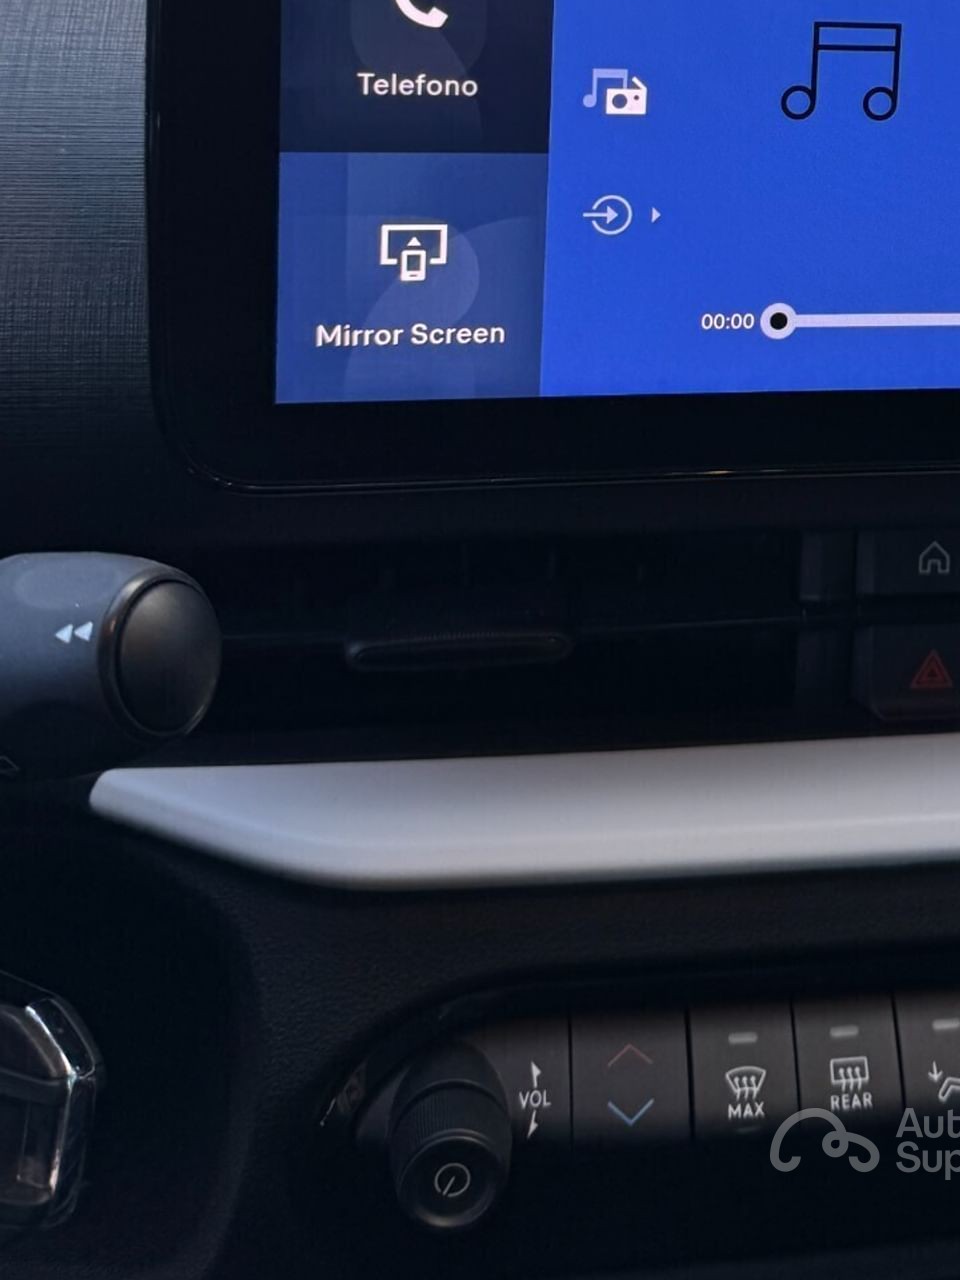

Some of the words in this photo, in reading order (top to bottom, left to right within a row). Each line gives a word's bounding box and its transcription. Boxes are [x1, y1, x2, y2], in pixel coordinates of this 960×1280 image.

[357, 73, 478, 97] Telefono
[701, 313, 755, 330] 00:00
[315, 323, 403, 348] Mirror
[411, 322, 505, 346] Screen
[518, 1090, 551, 1110] VOL
[830, 1092, 873, 1110] REAR
[727, 1101, 765, 1119] MAX
